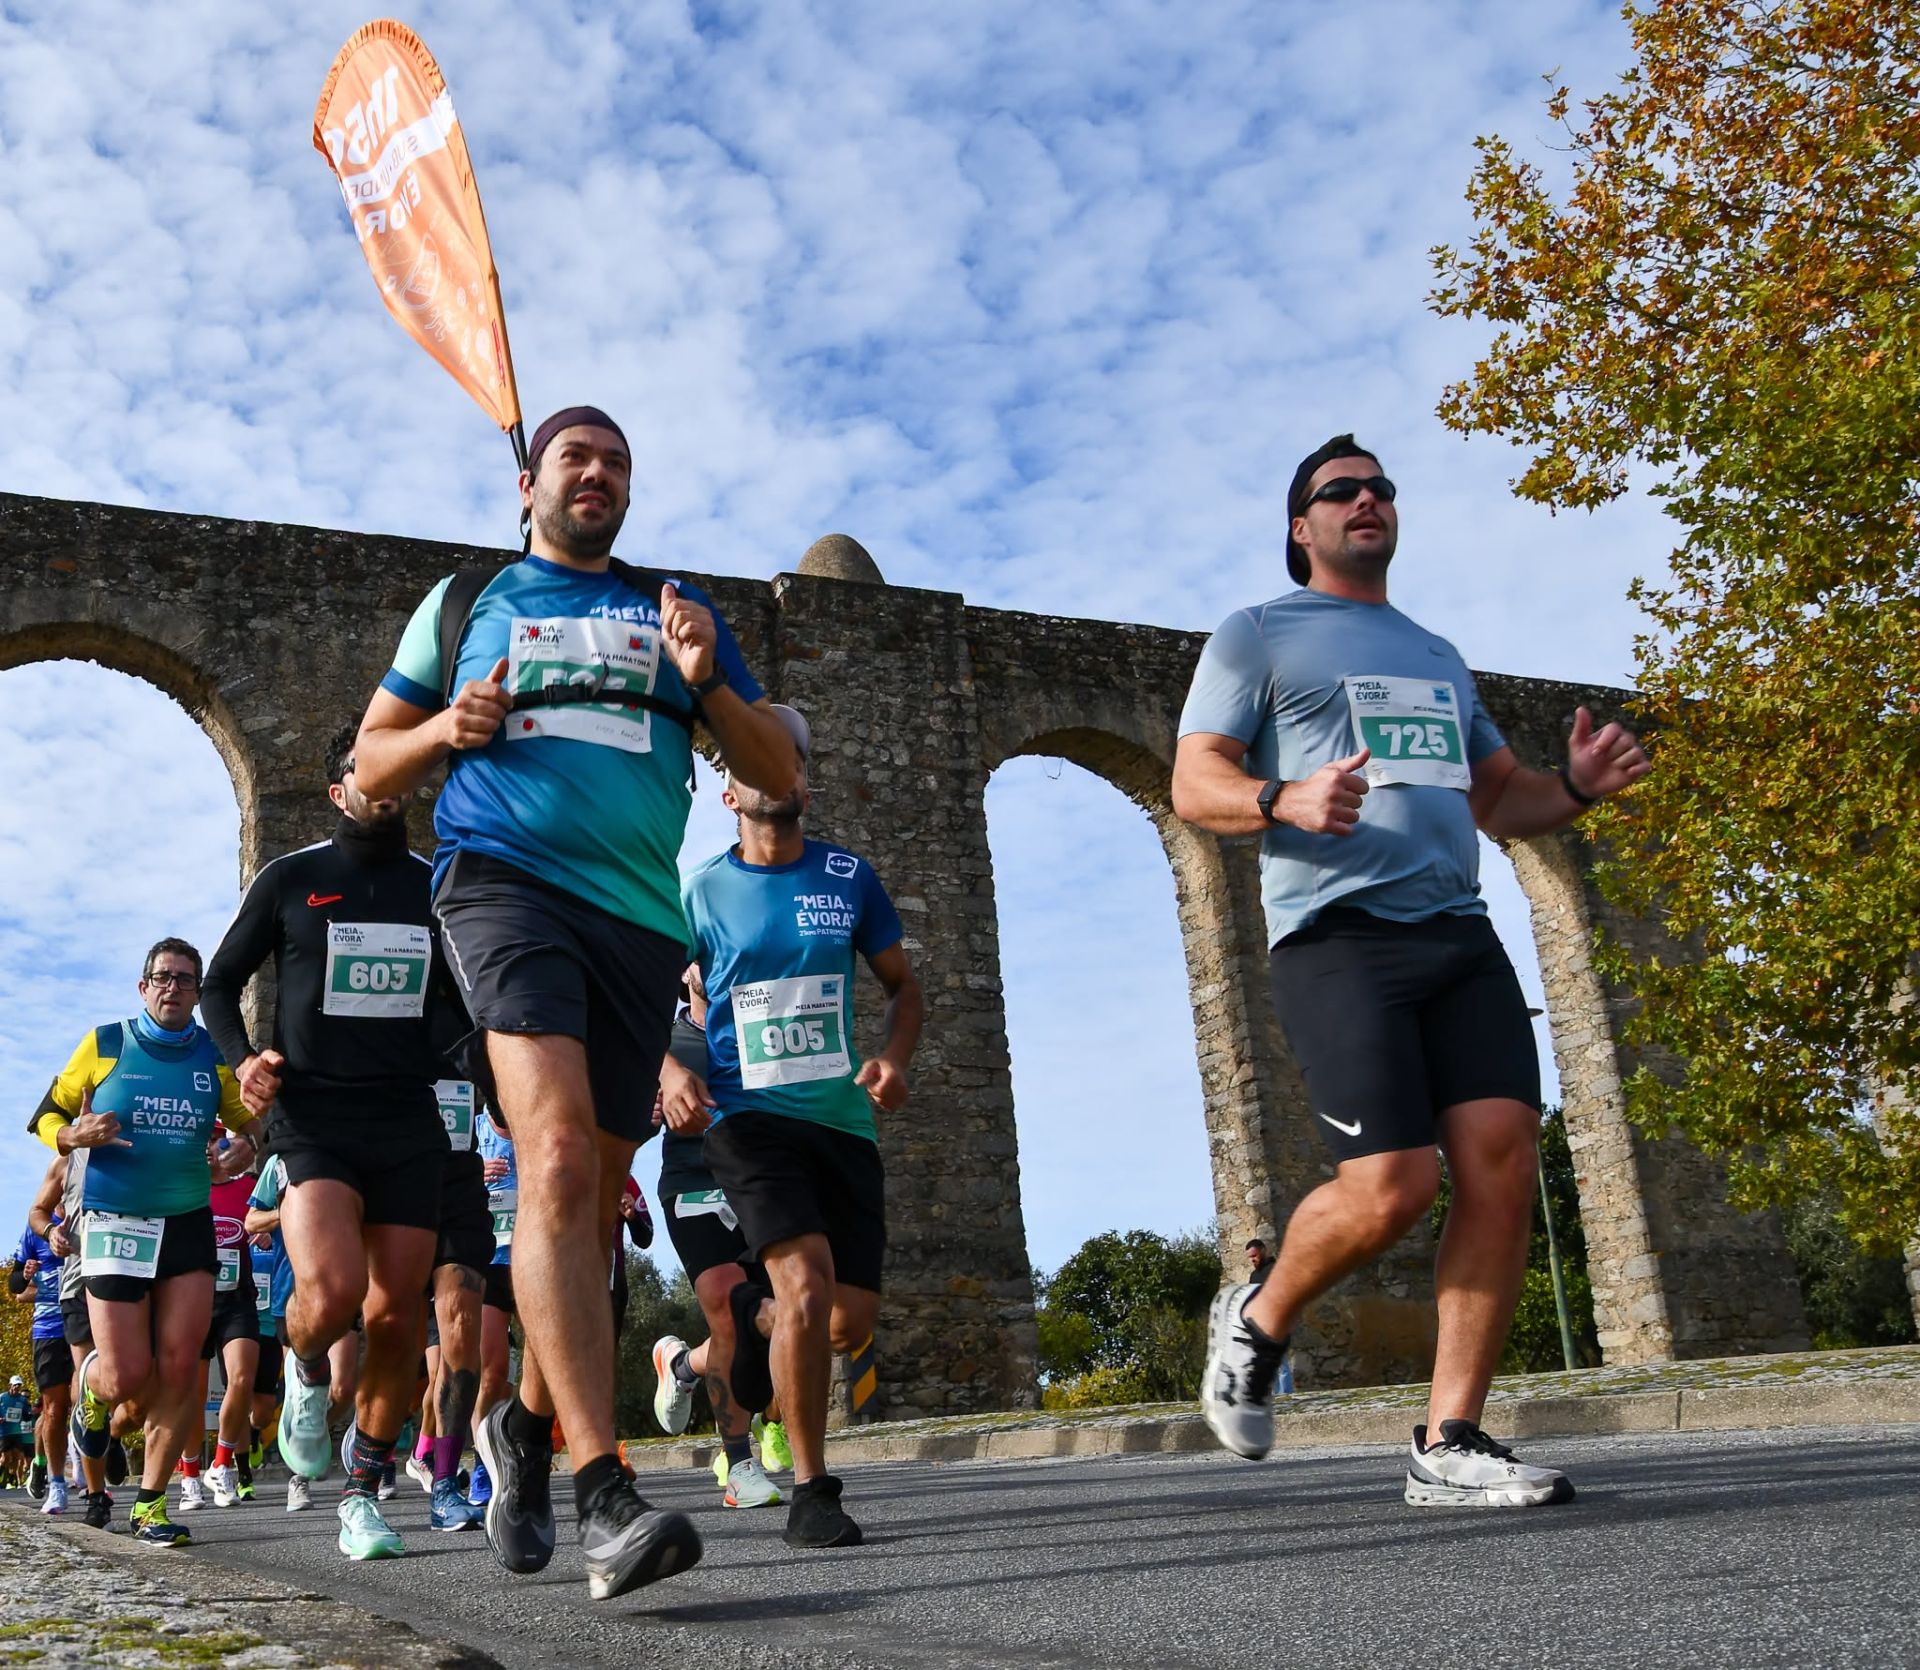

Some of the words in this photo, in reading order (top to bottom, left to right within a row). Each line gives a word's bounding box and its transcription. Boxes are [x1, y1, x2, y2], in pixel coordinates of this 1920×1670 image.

[1379, 723, 1449, 757] 725
[793, 894, 846, 910] "MEIA
[795, 909, 855, 928] ÉVORA"
[349, 961, 409, 991] 603
[761, 1020, 825, 1057] 905
[134, 1095, 193, 1114] "MEIA
[132, 1108, 206, 1129] ÉVORA"
[103, 1235, 138, 1258] 119
